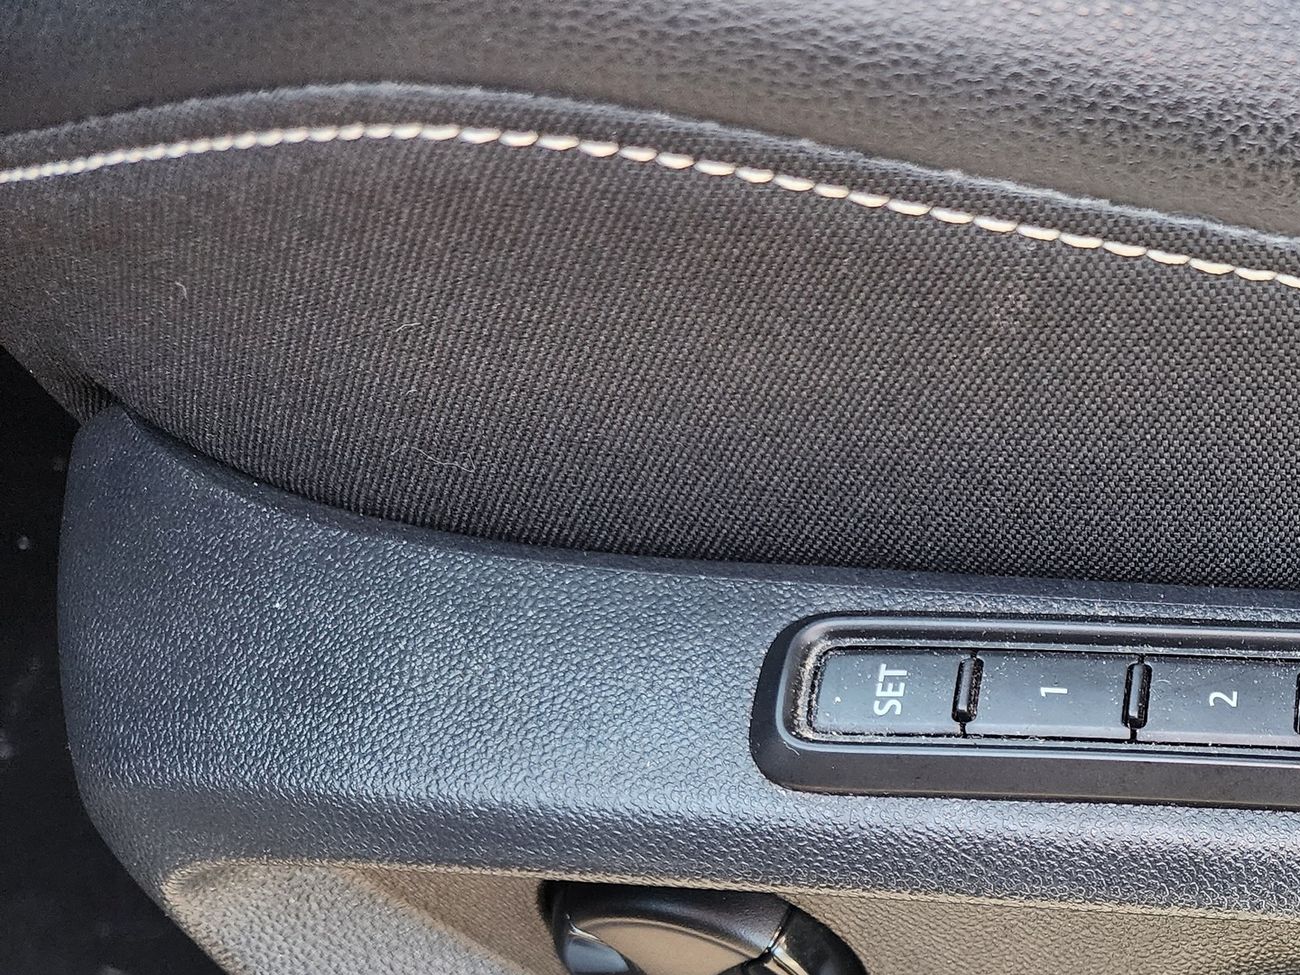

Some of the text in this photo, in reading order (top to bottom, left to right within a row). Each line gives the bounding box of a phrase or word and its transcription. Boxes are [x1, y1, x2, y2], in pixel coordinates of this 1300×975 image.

[873, 663, 908, 716] SET
[1040, 686, 1068, 697] 1
[1209, 691, 1238, 708] 2
